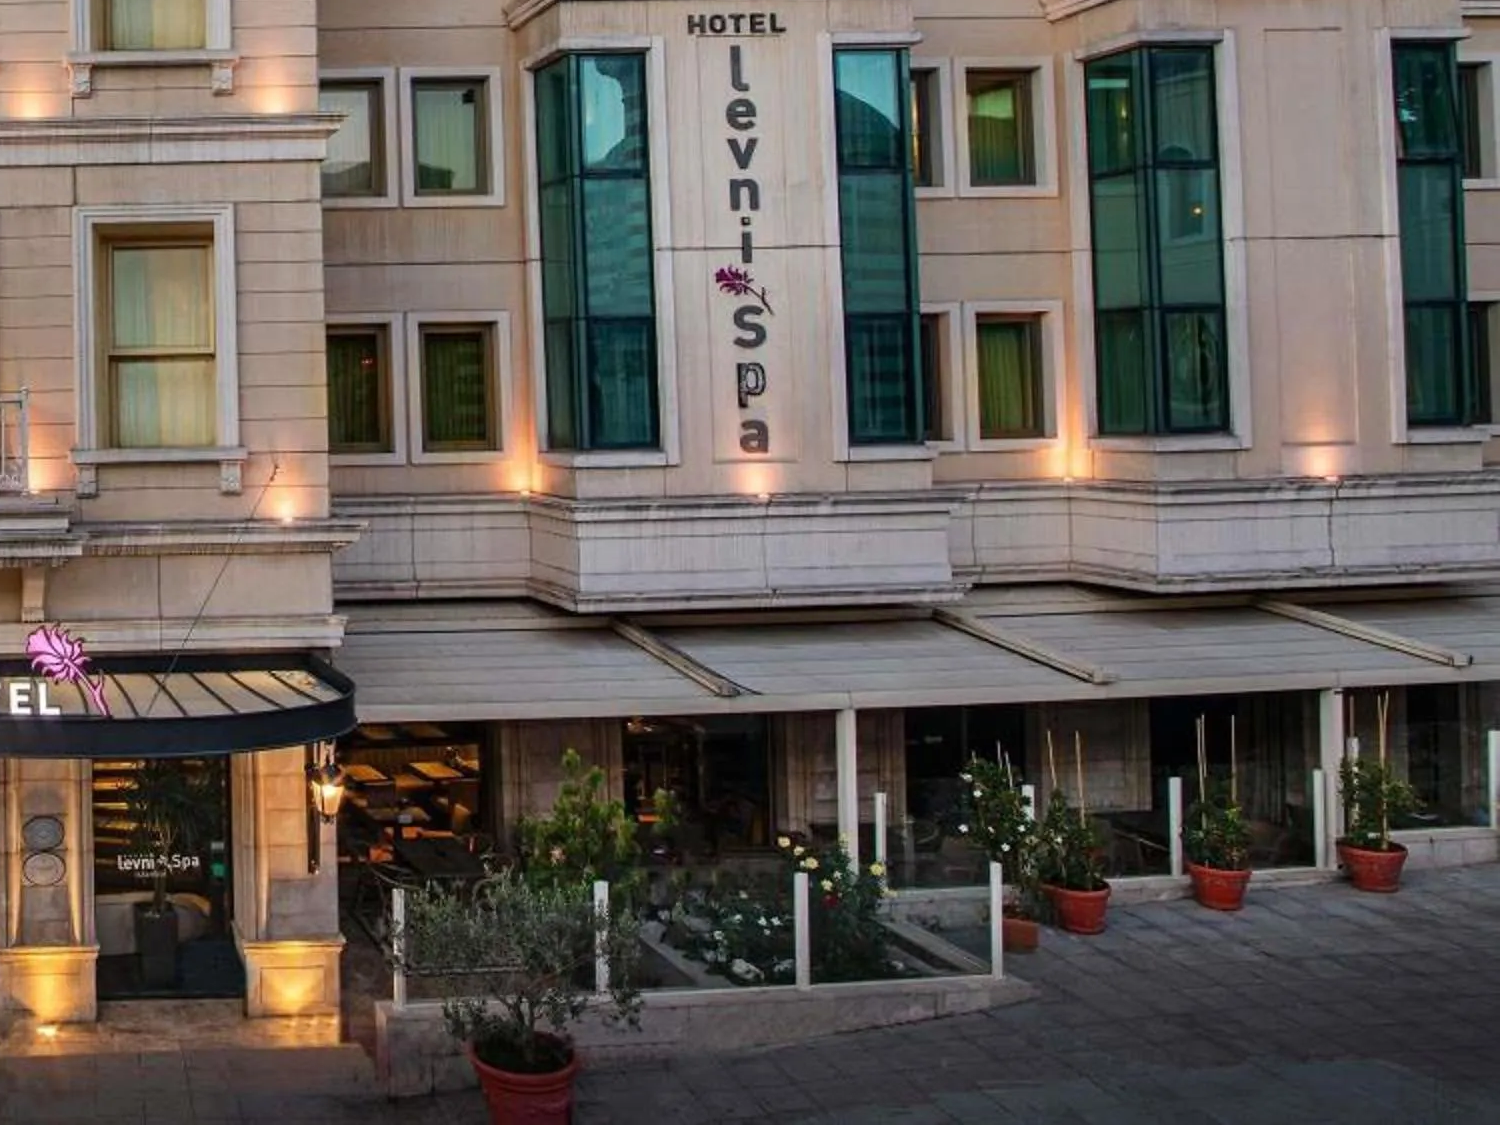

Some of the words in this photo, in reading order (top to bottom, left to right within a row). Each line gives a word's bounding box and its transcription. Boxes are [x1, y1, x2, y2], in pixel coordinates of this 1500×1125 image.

[687, 12, 787, 35] HOTEL
[725, 44, 761, 264] levni
[732, 304, 769, 454] Spa
[117, 853, 156, 870] levni
[171, 854, 200, 872] Spa
